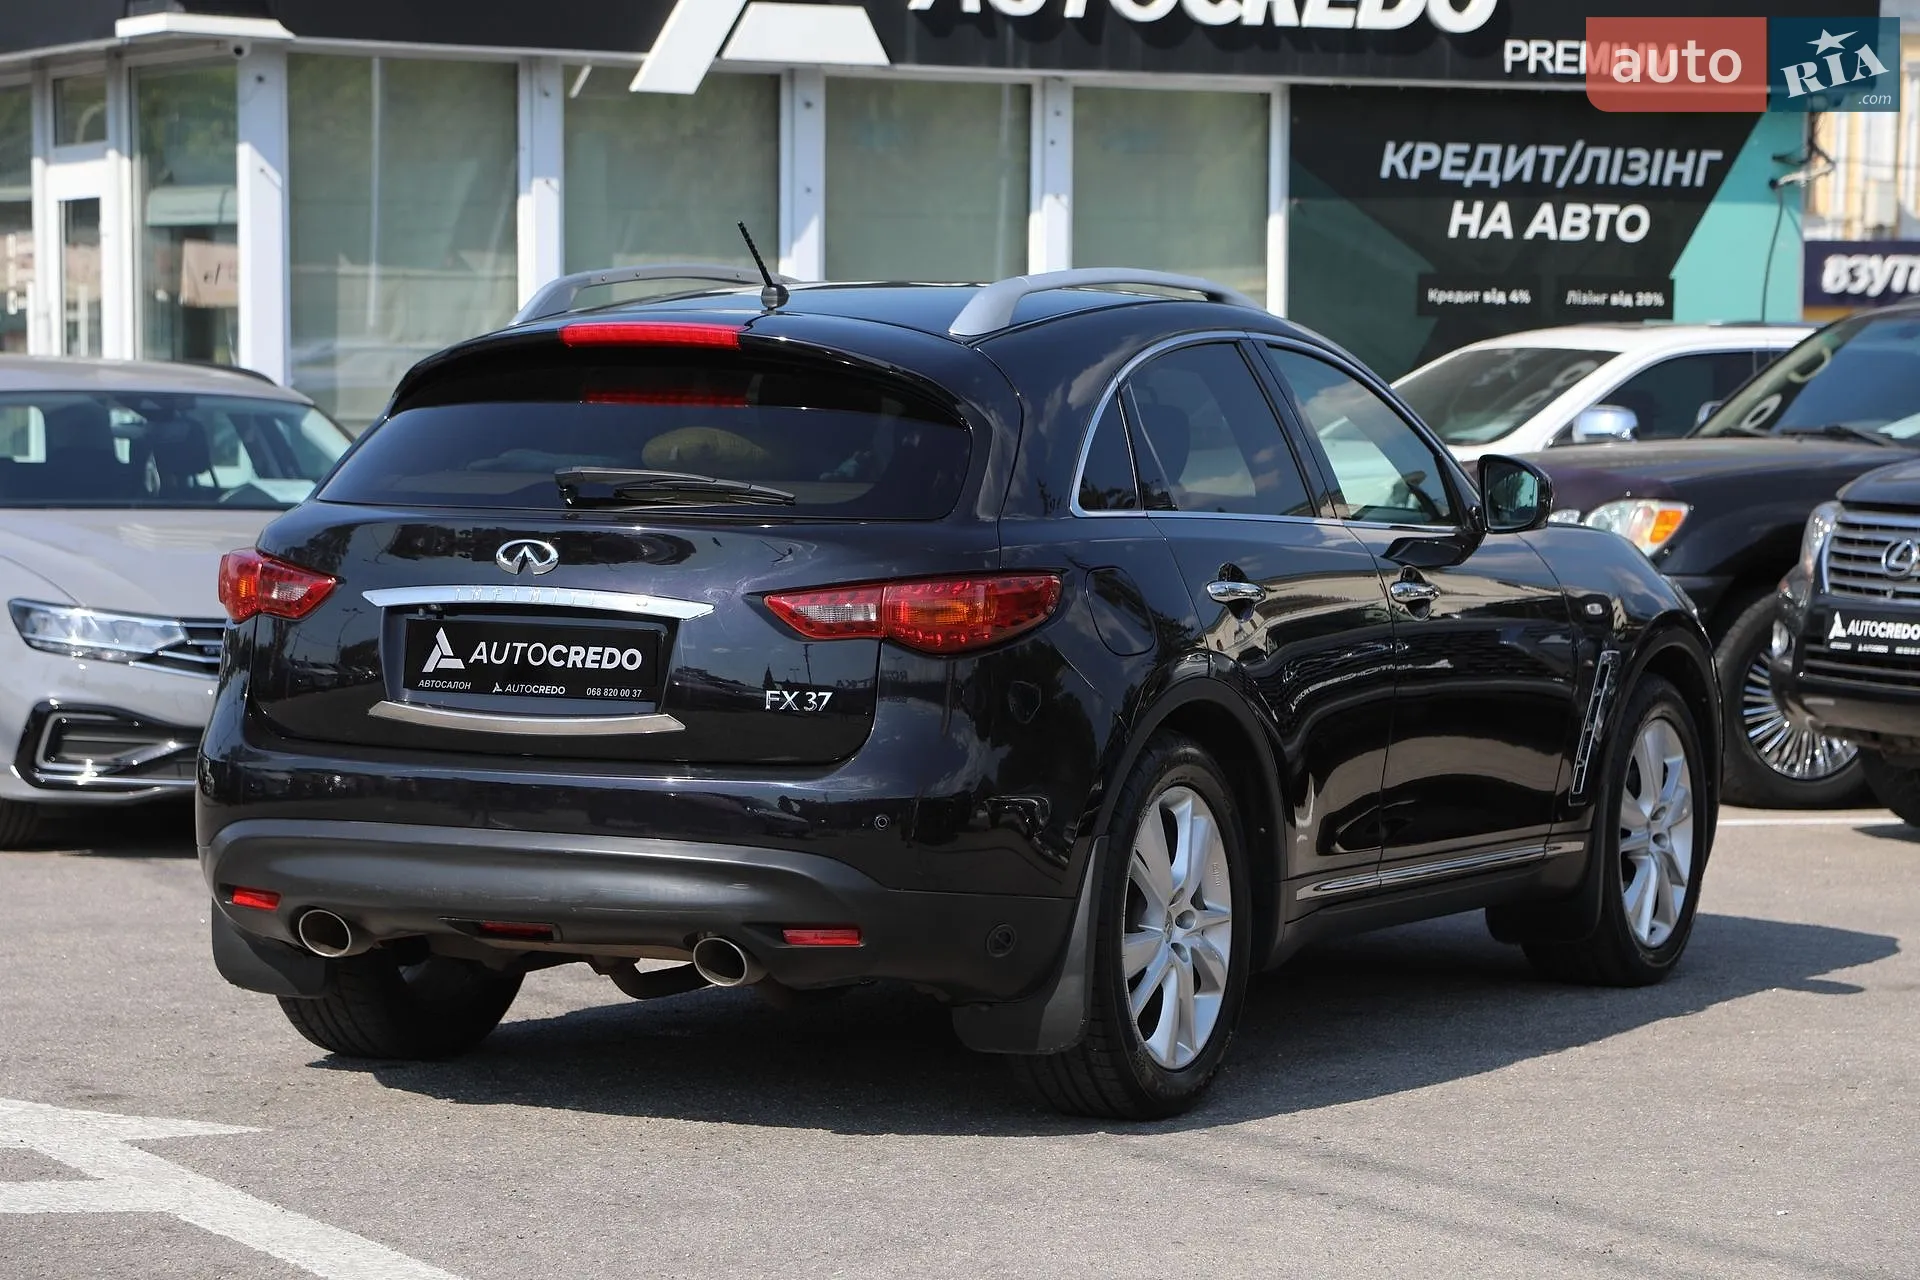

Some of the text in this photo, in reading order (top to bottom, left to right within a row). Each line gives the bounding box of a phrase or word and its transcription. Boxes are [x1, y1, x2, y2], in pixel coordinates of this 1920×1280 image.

[1380, 139, 1724, 189] КРЕДИТ/ЛІЗІНГ
[1447, 200, 1652, 244] НА АВТО
[1427, 287, 1532, 305] Кредит від 4%
[1565, 289, 1665, 308] Лізінг від 20%
[1846, 619, 1920, 641] AUTOCREDO
[468, 641, 643, 671] AUTOCREDO
[417, 679, 472, 690] АВТОСАЛОН
[504, 683, 566, 695] AUTOCREDO
[586, 687, 642, 698] 068 820 00 37
[765, 690, 833, 712] FX 37
